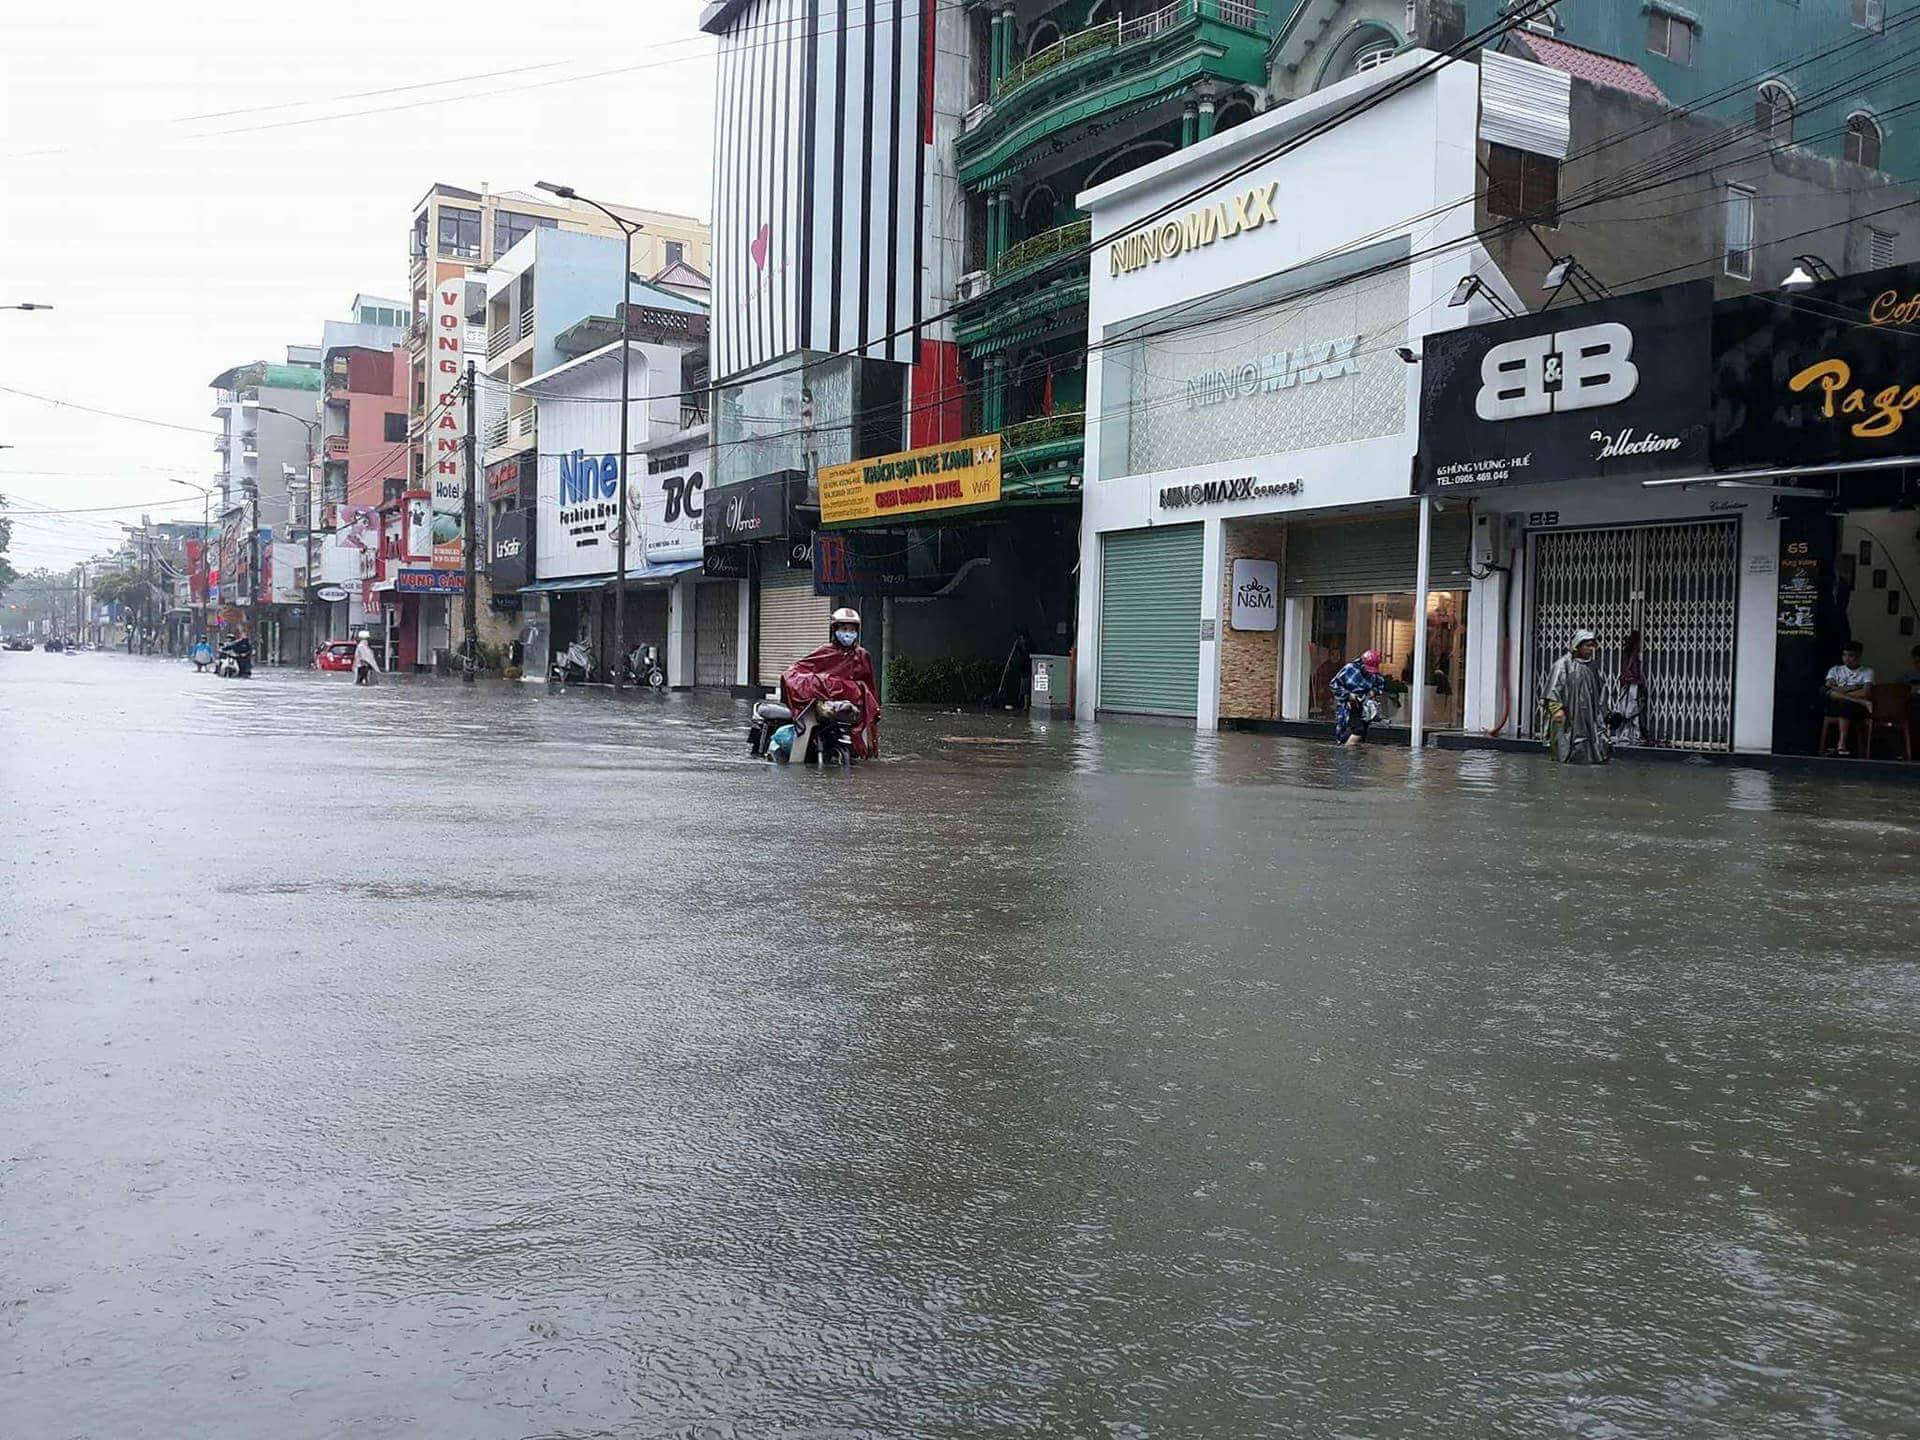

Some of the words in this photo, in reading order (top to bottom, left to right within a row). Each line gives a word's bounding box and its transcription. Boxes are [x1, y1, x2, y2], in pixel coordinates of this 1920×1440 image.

[1110, 181, 1280, 277] NINOMAXX
[1187, 335, 1362, 409] NINOMAXX
[436, 482, 460, 499] Hotel
[560, 448, 618, 506] Nine
[662, 471, 703, 523] BC
[1159, 477, 1257, 511] NINOMAXX
[560, 506, 596, 526] Fashion
